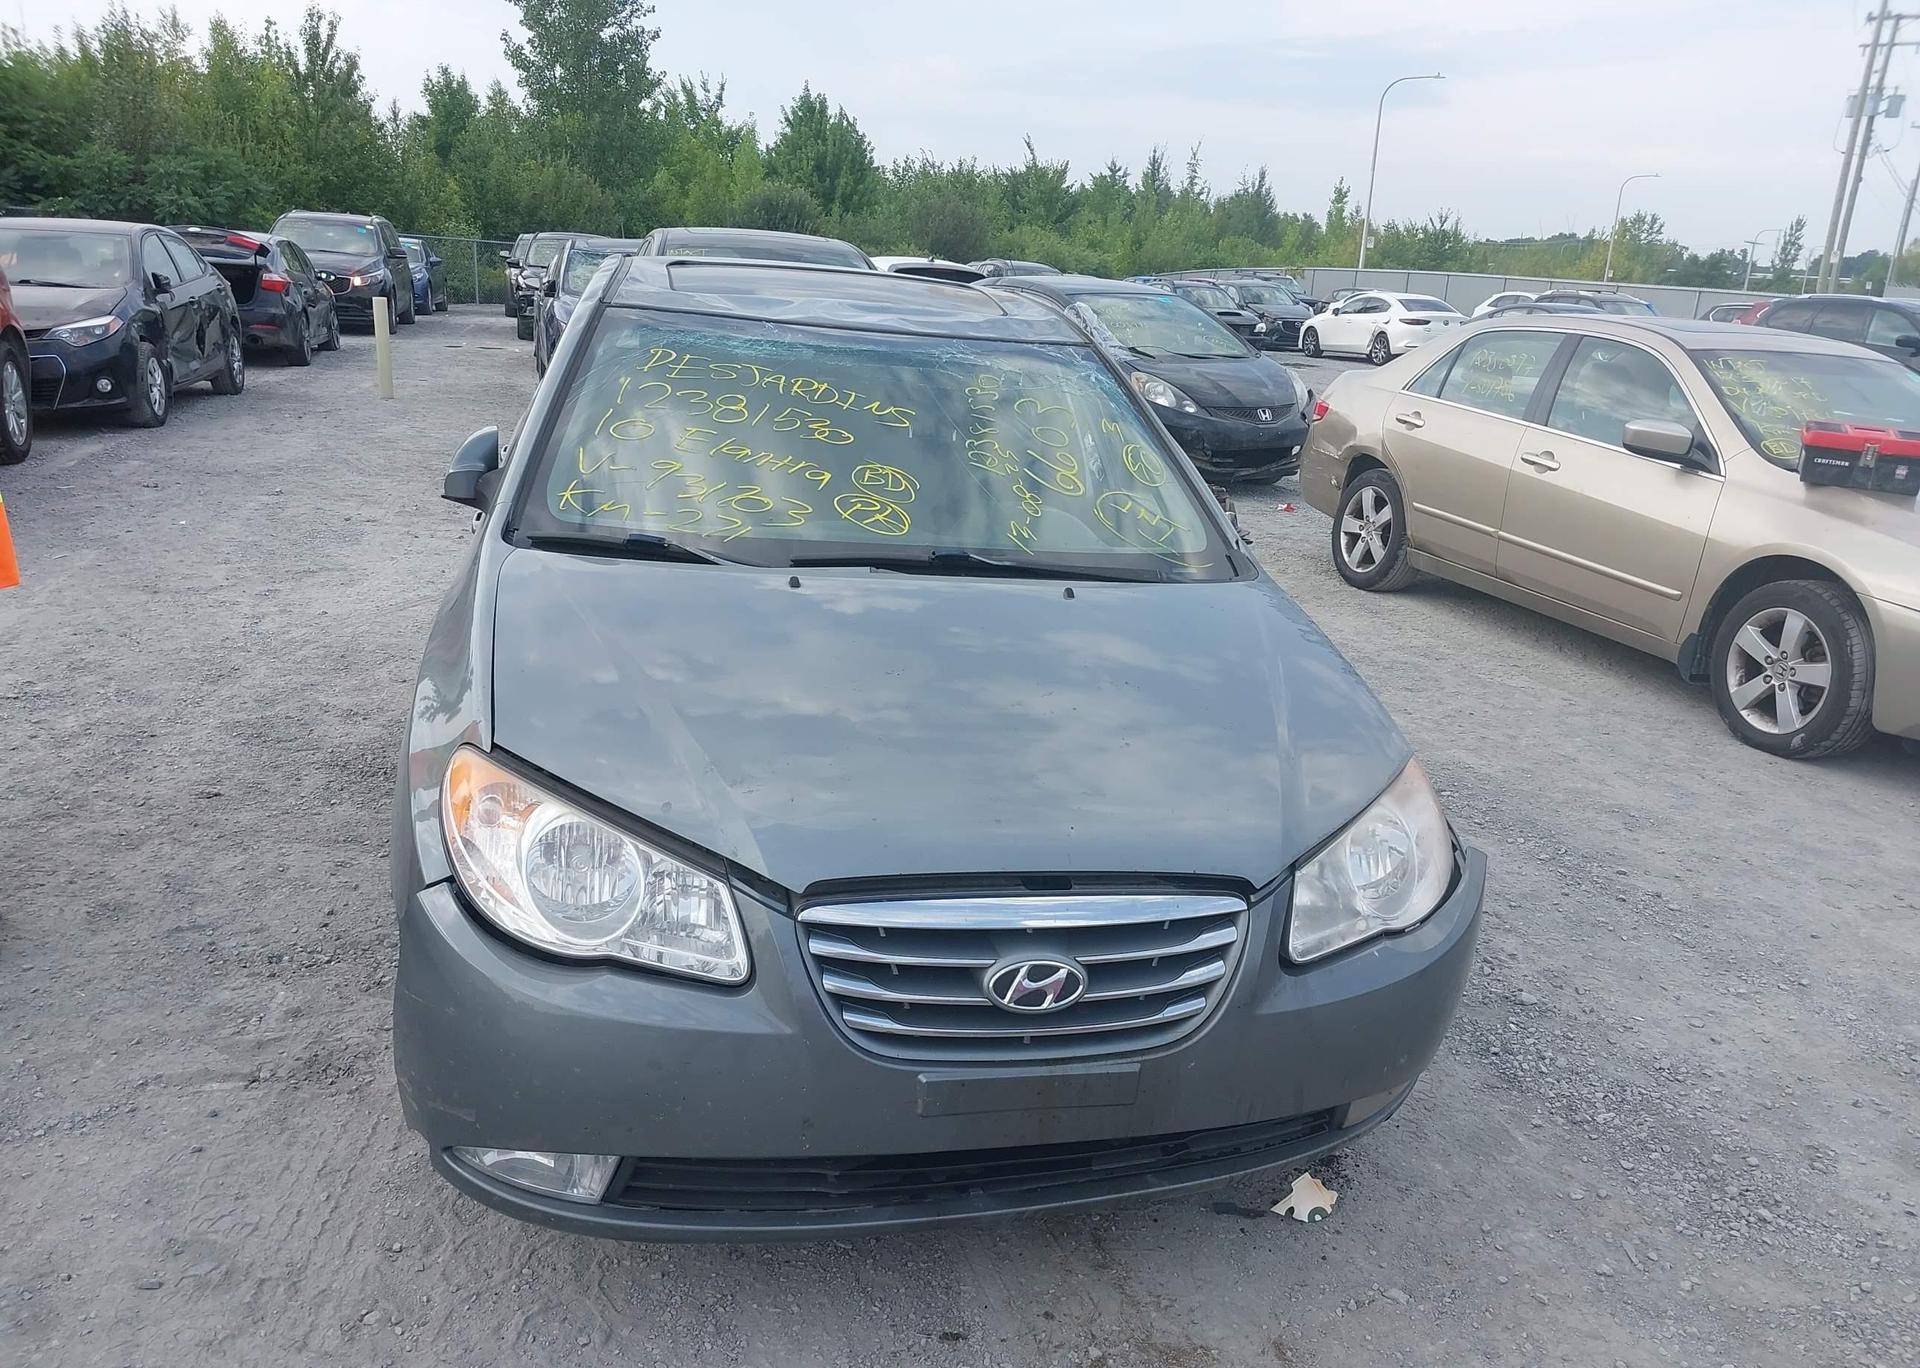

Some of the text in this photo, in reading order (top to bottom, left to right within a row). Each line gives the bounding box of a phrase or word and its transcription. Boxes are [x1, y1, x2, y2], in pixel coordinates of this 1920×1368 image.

[616, 377, 855, 445] 12381530
[636, 348, 917, 428] DESJARDINS
[594, 408, 832, 490] 10 Elantra
[1014, 397, 1086, 497] 6603
